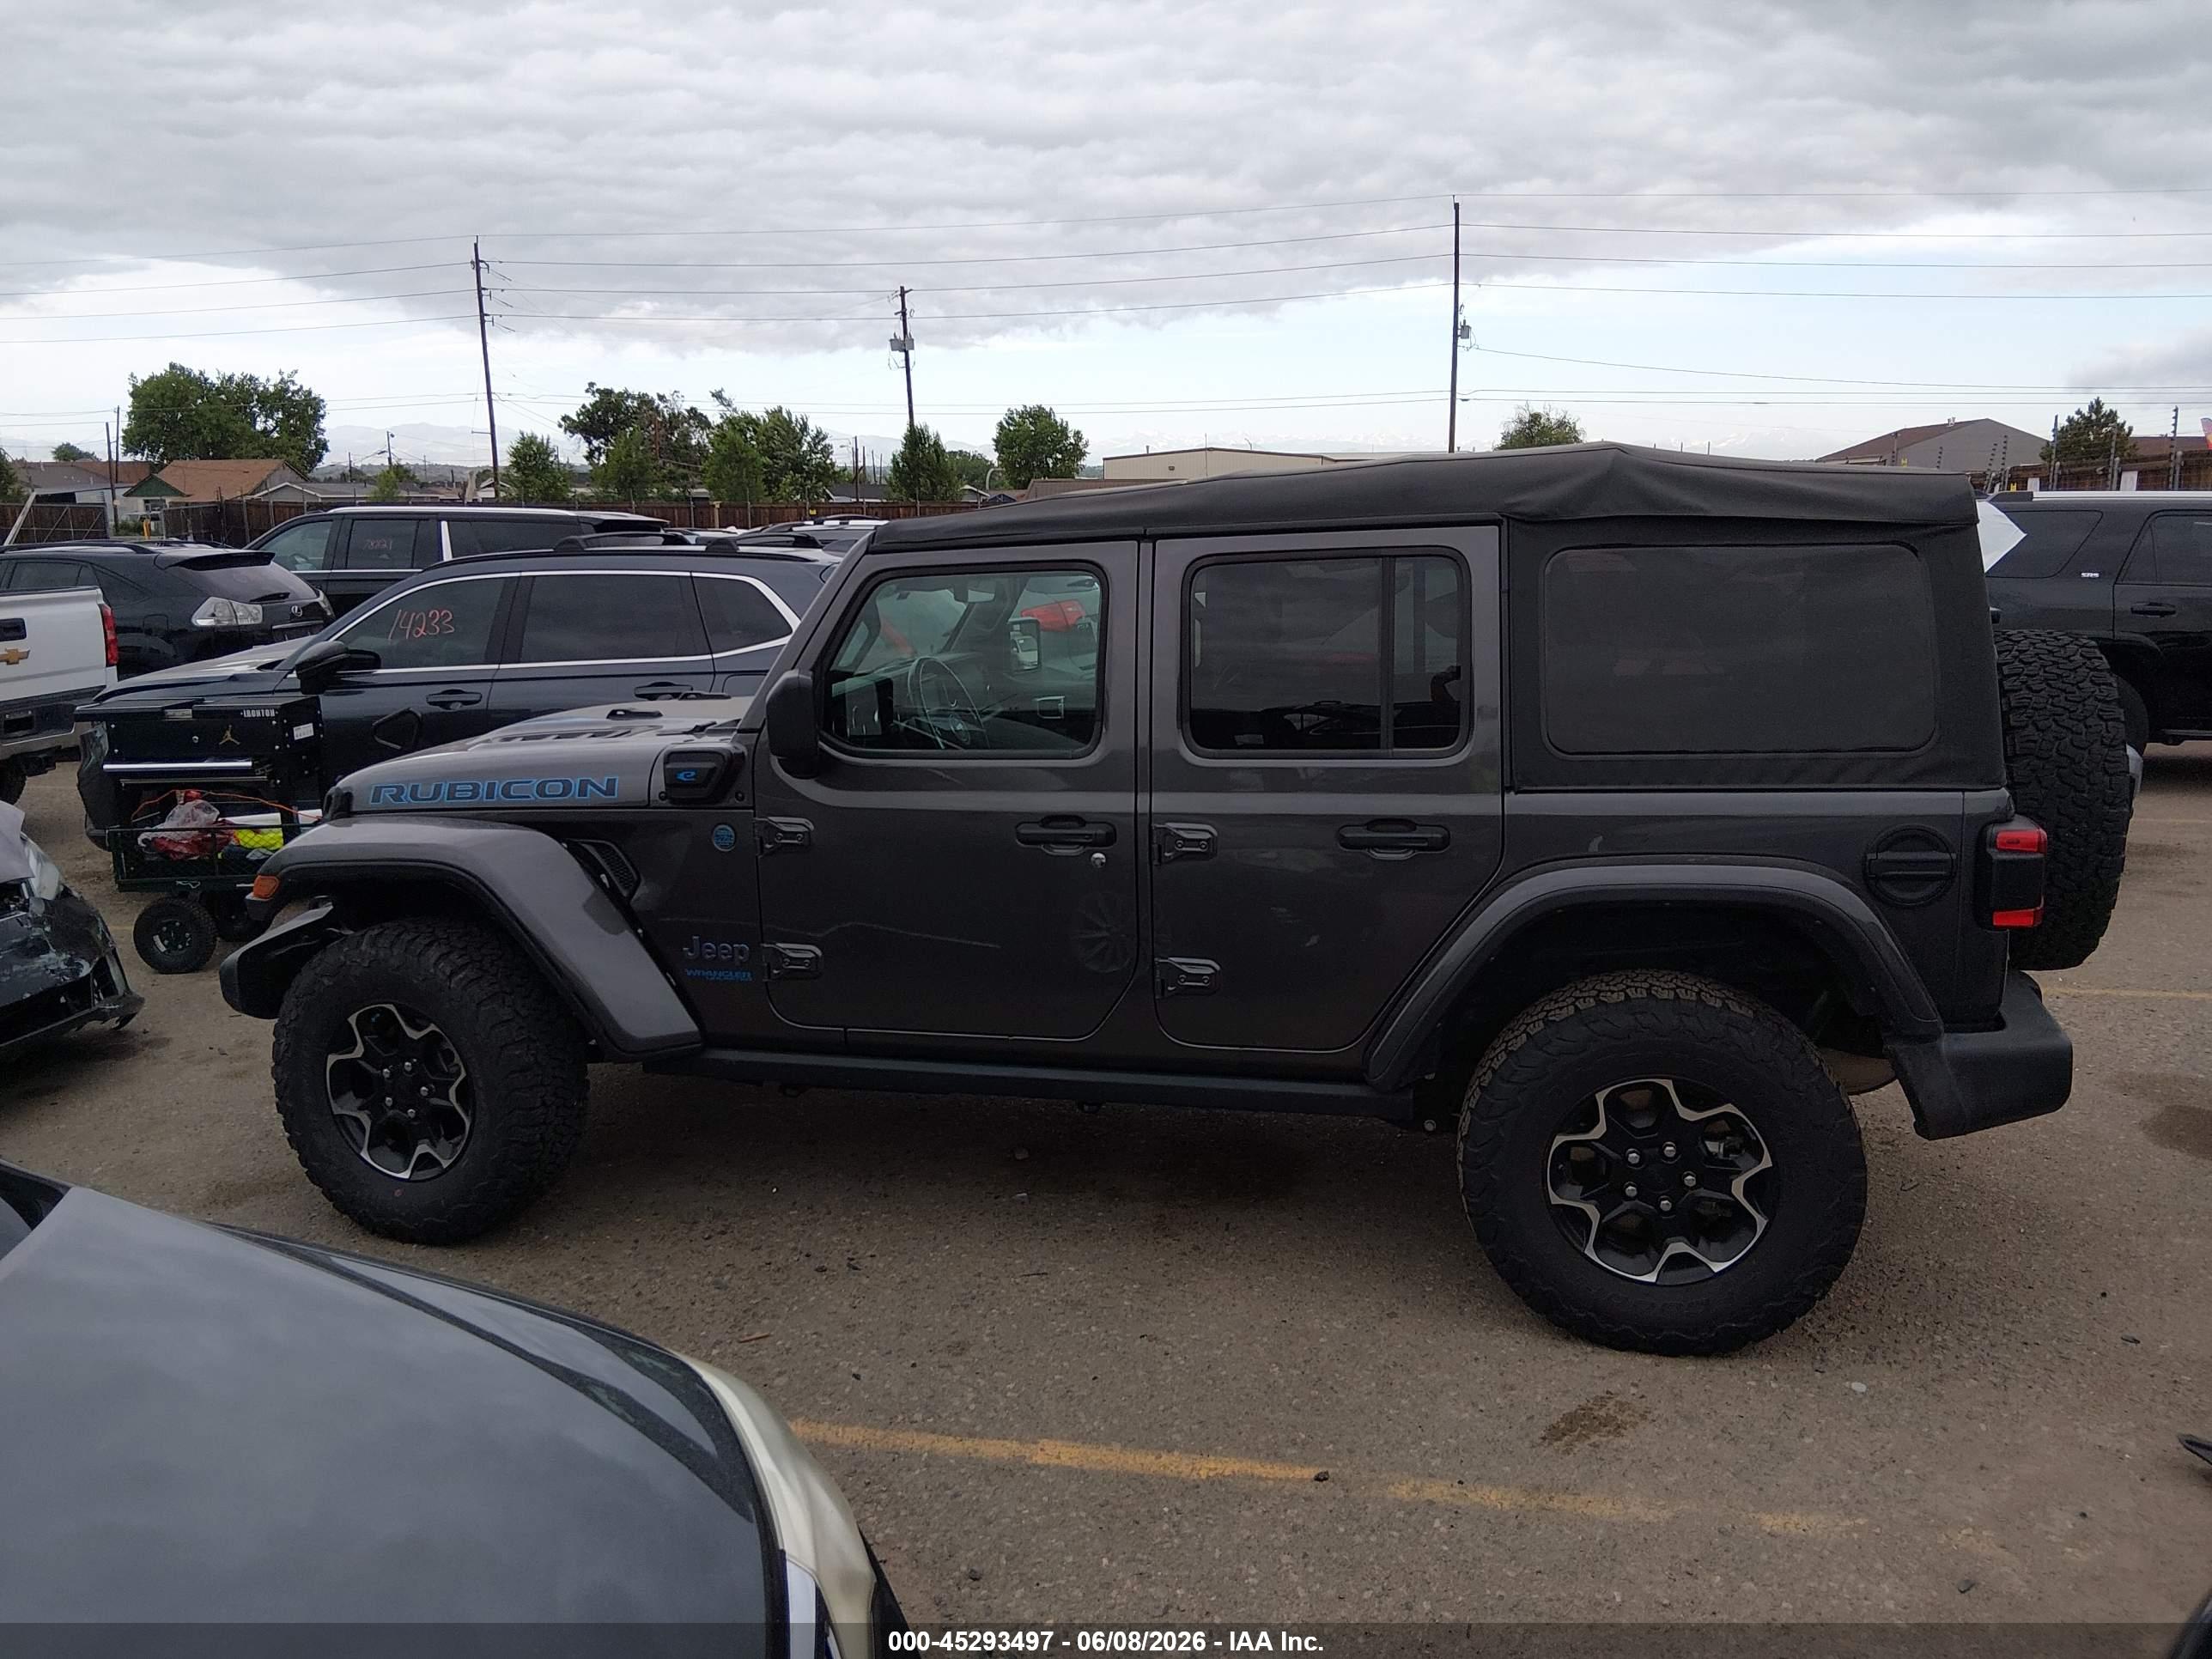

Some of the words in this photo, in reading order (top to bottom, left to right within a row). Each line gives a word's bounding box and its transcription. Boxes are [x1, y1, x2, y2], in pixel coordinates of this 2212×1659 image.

[388, 609, 455, 641] 14233
[369, 776, 618, 804] RUBICON
[683, 935, 750, 965] Jeep
